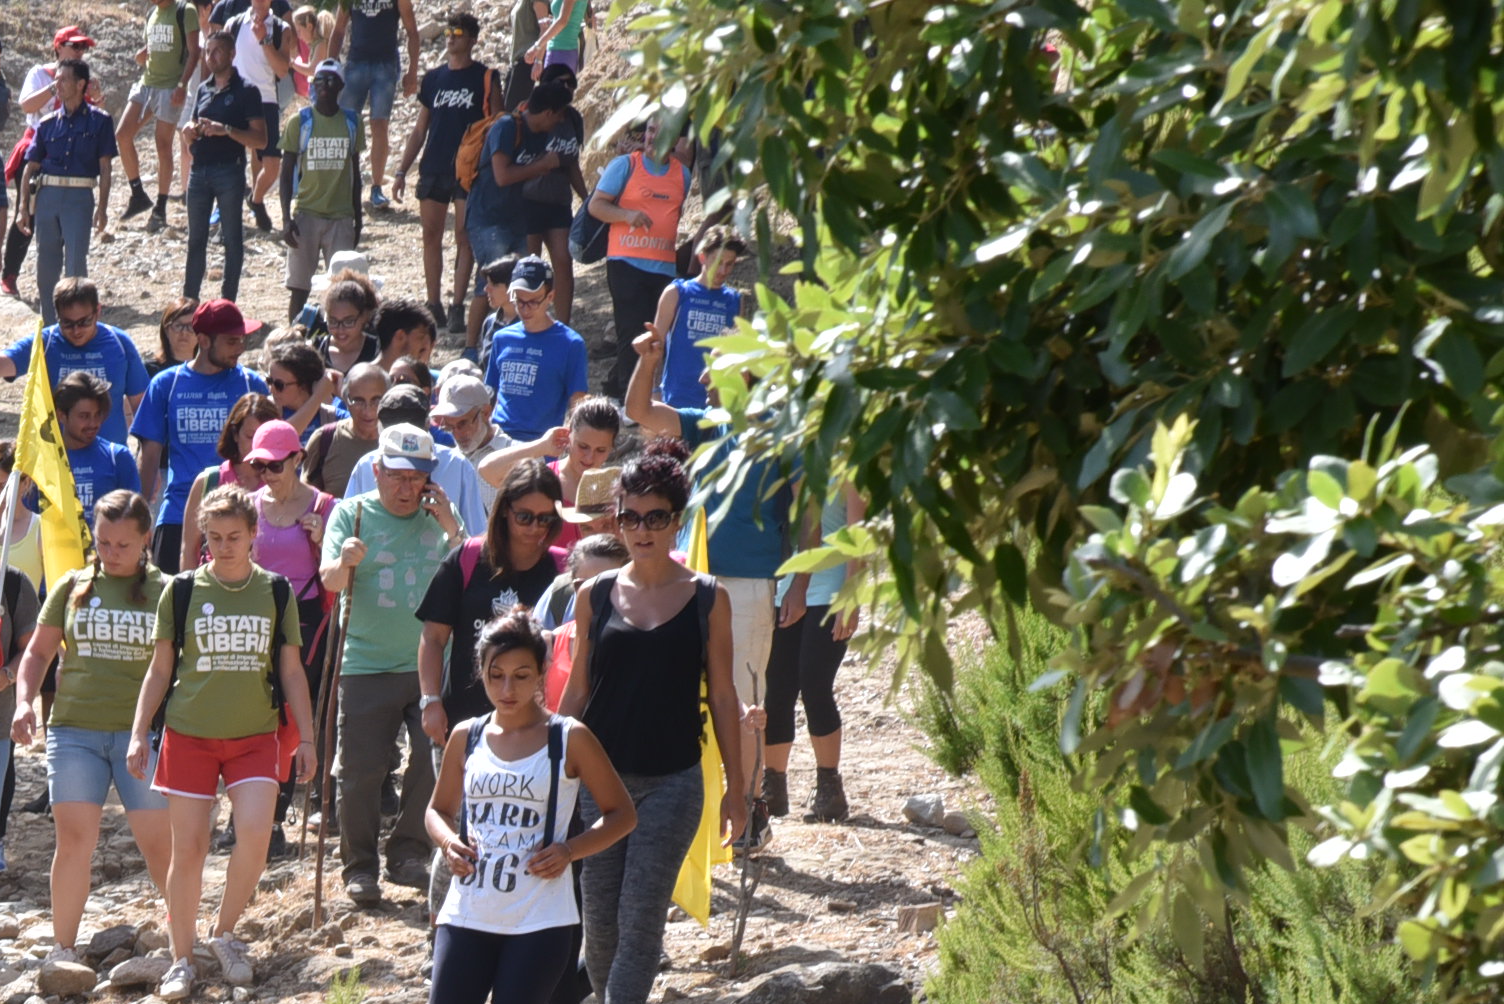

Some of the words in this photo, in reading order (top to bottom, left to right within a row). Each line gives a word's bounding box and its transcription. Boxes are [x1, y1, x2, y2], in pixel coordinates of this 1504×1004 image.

[176, 407, 228, 419] E!STATE
[75, 607, 157, 628] E!STATE
[194, 615, 271, 636] E!STATE
[196, 633, 271, 654] LIBERI!
[470, 773, 535, 800] WORK
